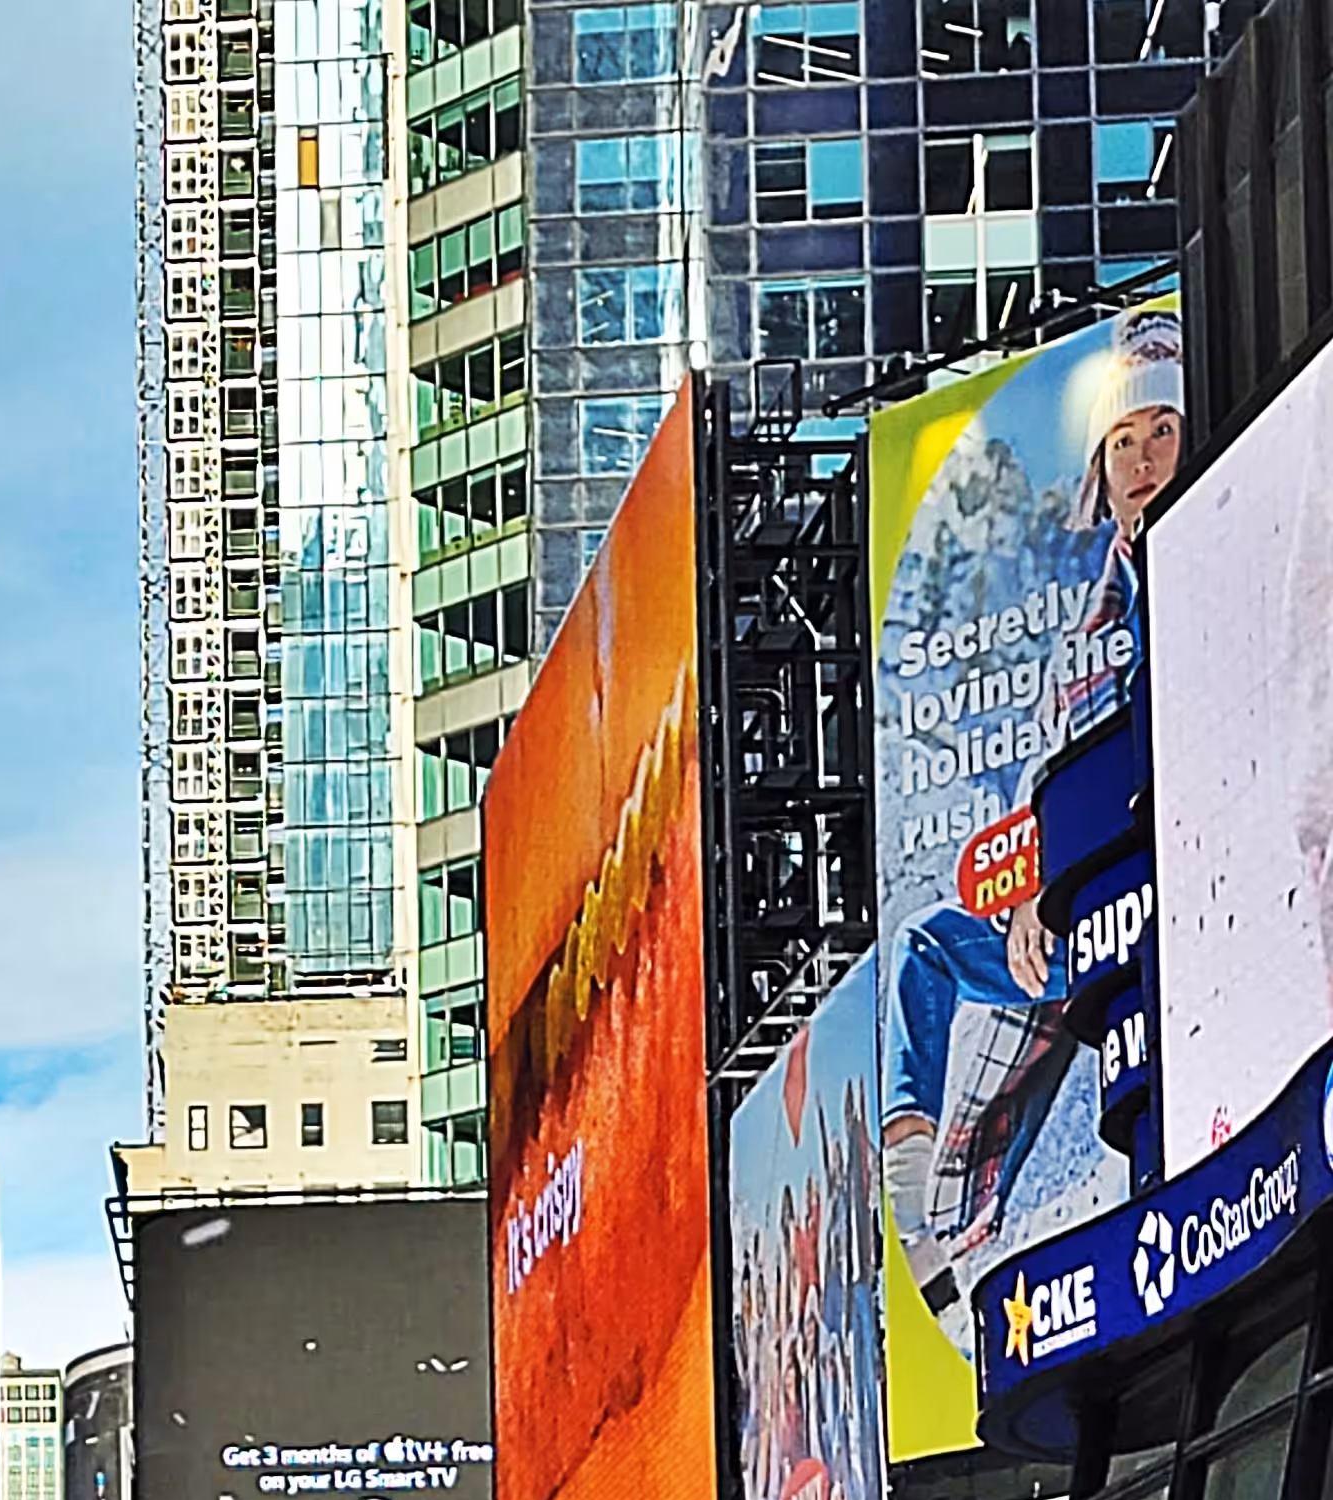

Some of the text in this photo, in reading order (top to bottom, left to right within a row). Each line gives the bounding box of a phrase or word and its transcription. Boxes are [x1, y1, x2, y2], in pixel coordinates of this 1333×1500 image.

[899, 580, 1094, 678] Secretly
[901, 623, 1133, 738] loving the
[901, 709, 1071, 796] holiday
[901, 790, 1001, 855] rush
[974, 816, 1038, 872] sorr
[976, 855, 1027, 910] not
[1032, 1264, 1096, 1338] CKE
[222, 1446, 261, 1467] Get
[262, 1444, 279, 1466] 3
[280, 1443, 353, 1465] months
[355, 1442, 380, 1464] of
[451, 1439, 494, 1463] free
[259, 1466, 458, 1495] on your LG Smart TV
